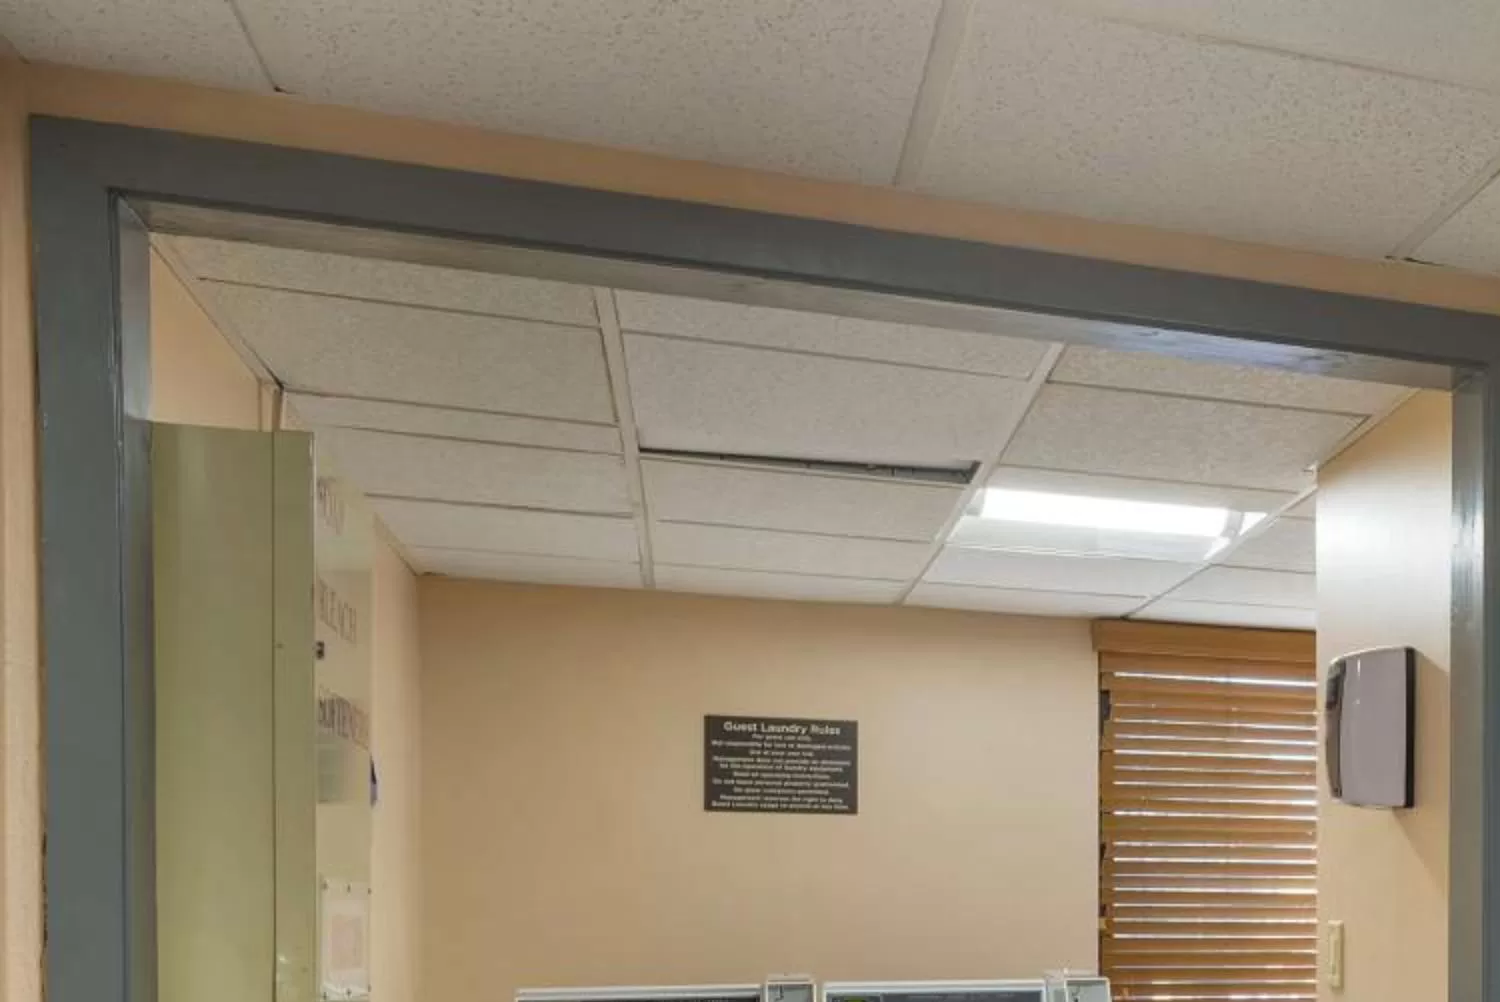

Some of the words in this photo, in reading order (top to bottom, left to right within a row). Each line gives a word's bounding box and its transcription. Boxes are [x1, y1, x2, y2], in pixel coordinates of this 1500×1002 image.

[723, 721, 757, 732] Guest
[761, 723, 808, 735] Laundry
[811, 724, 841, 735] Rules
